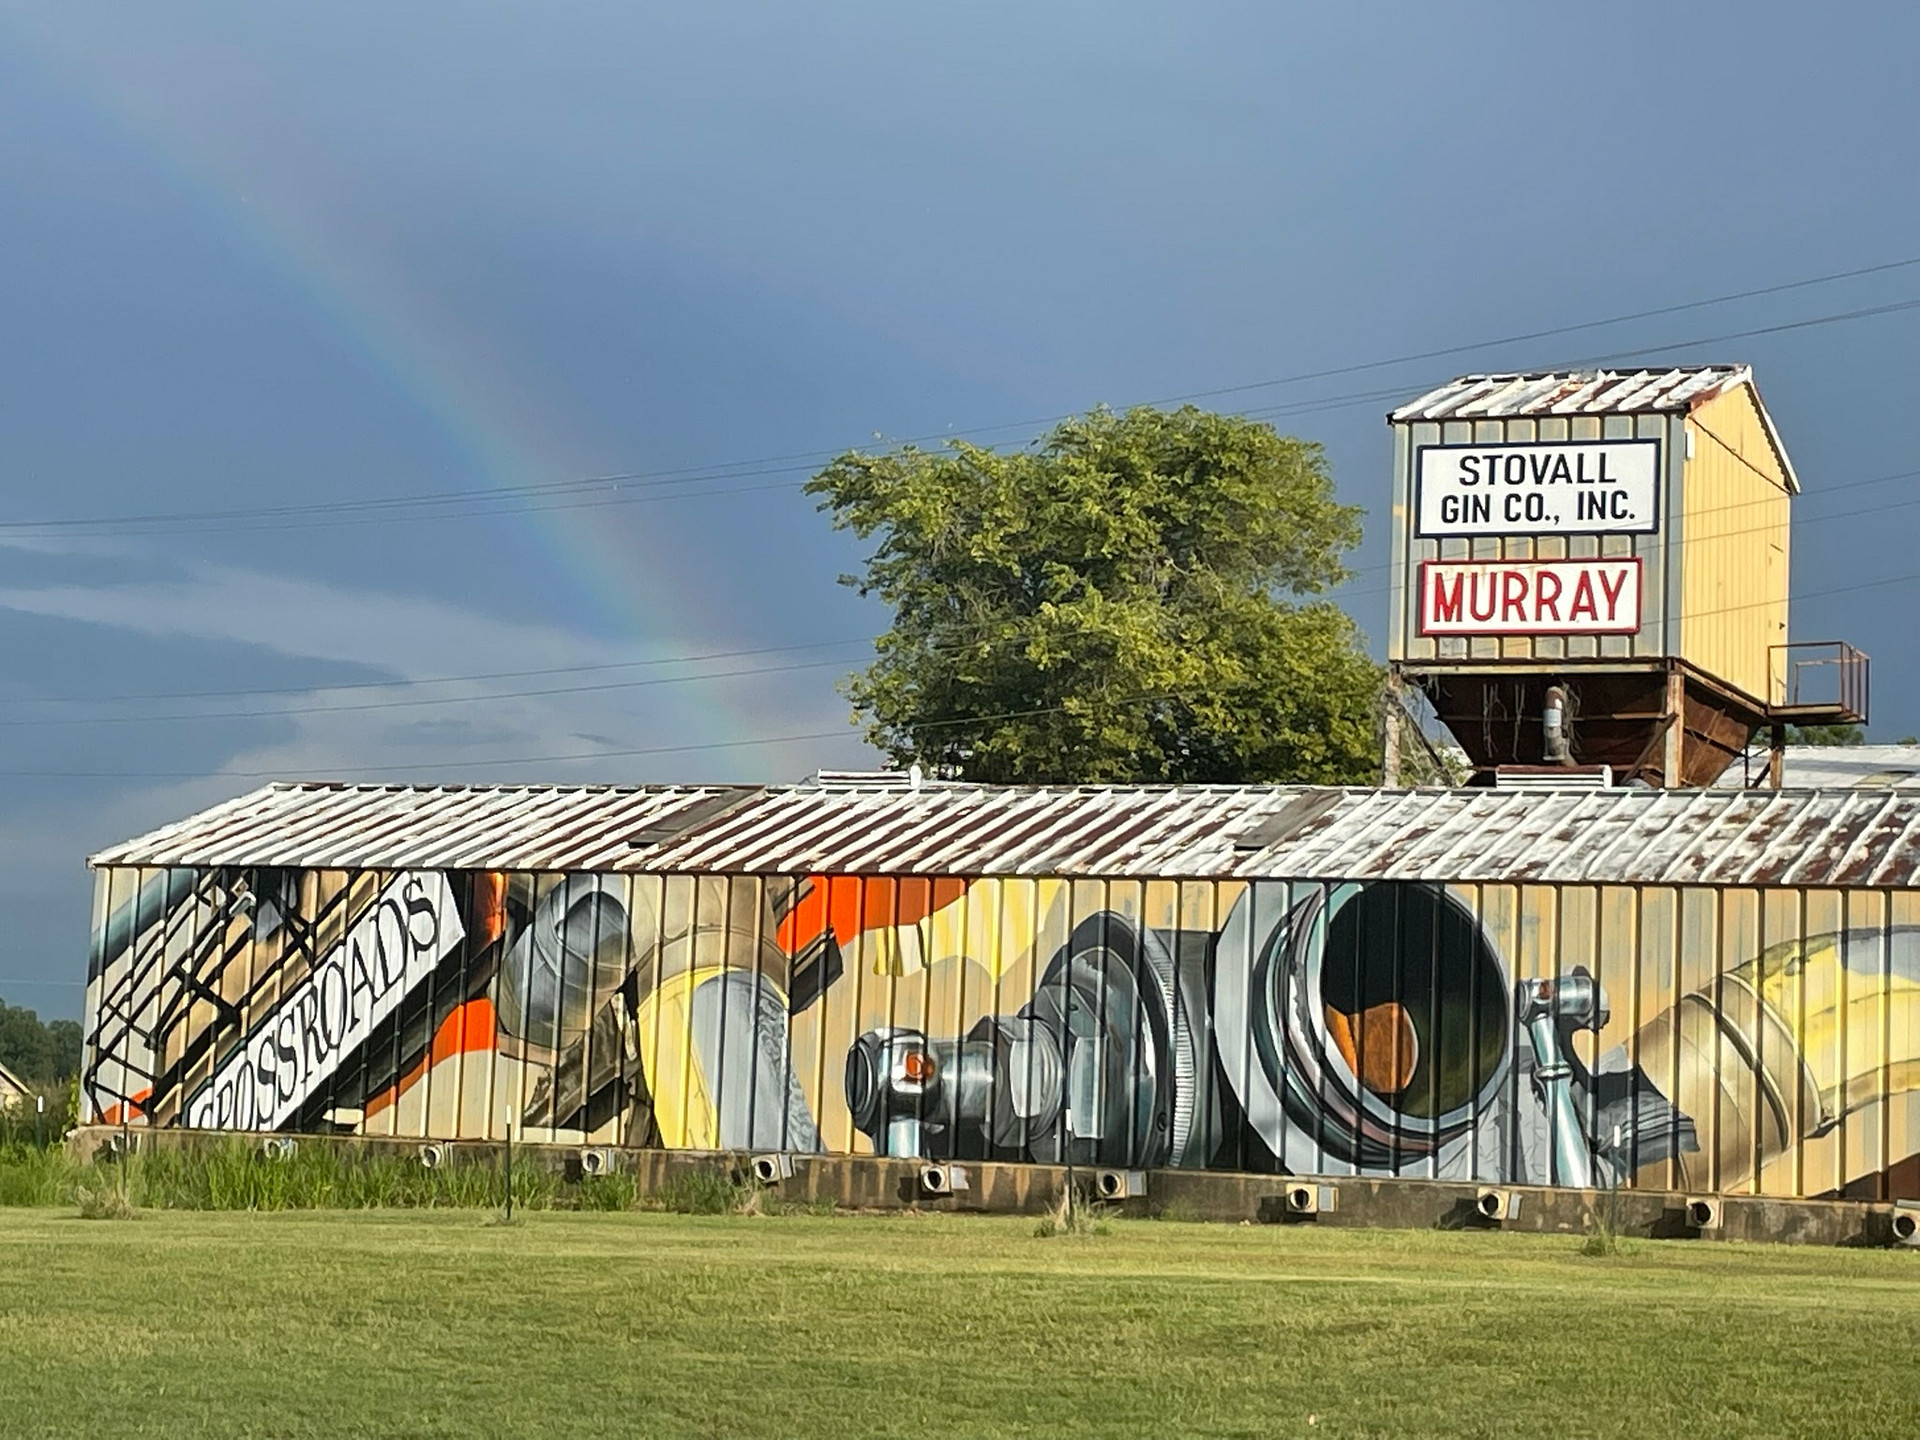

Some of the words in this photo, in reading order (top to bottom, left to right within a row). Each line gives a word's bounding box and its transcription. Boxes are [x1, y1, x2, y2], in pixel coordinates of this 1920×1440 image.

[1459, 453, 1616, 486] STOVALL
[1441, 495, 1491, 524] GIN
[1504, 493, 1559, 525] CO.,
[1577, 490, 1635, 520] INC.
[1433, 569, 1628, 623] MURRAY
